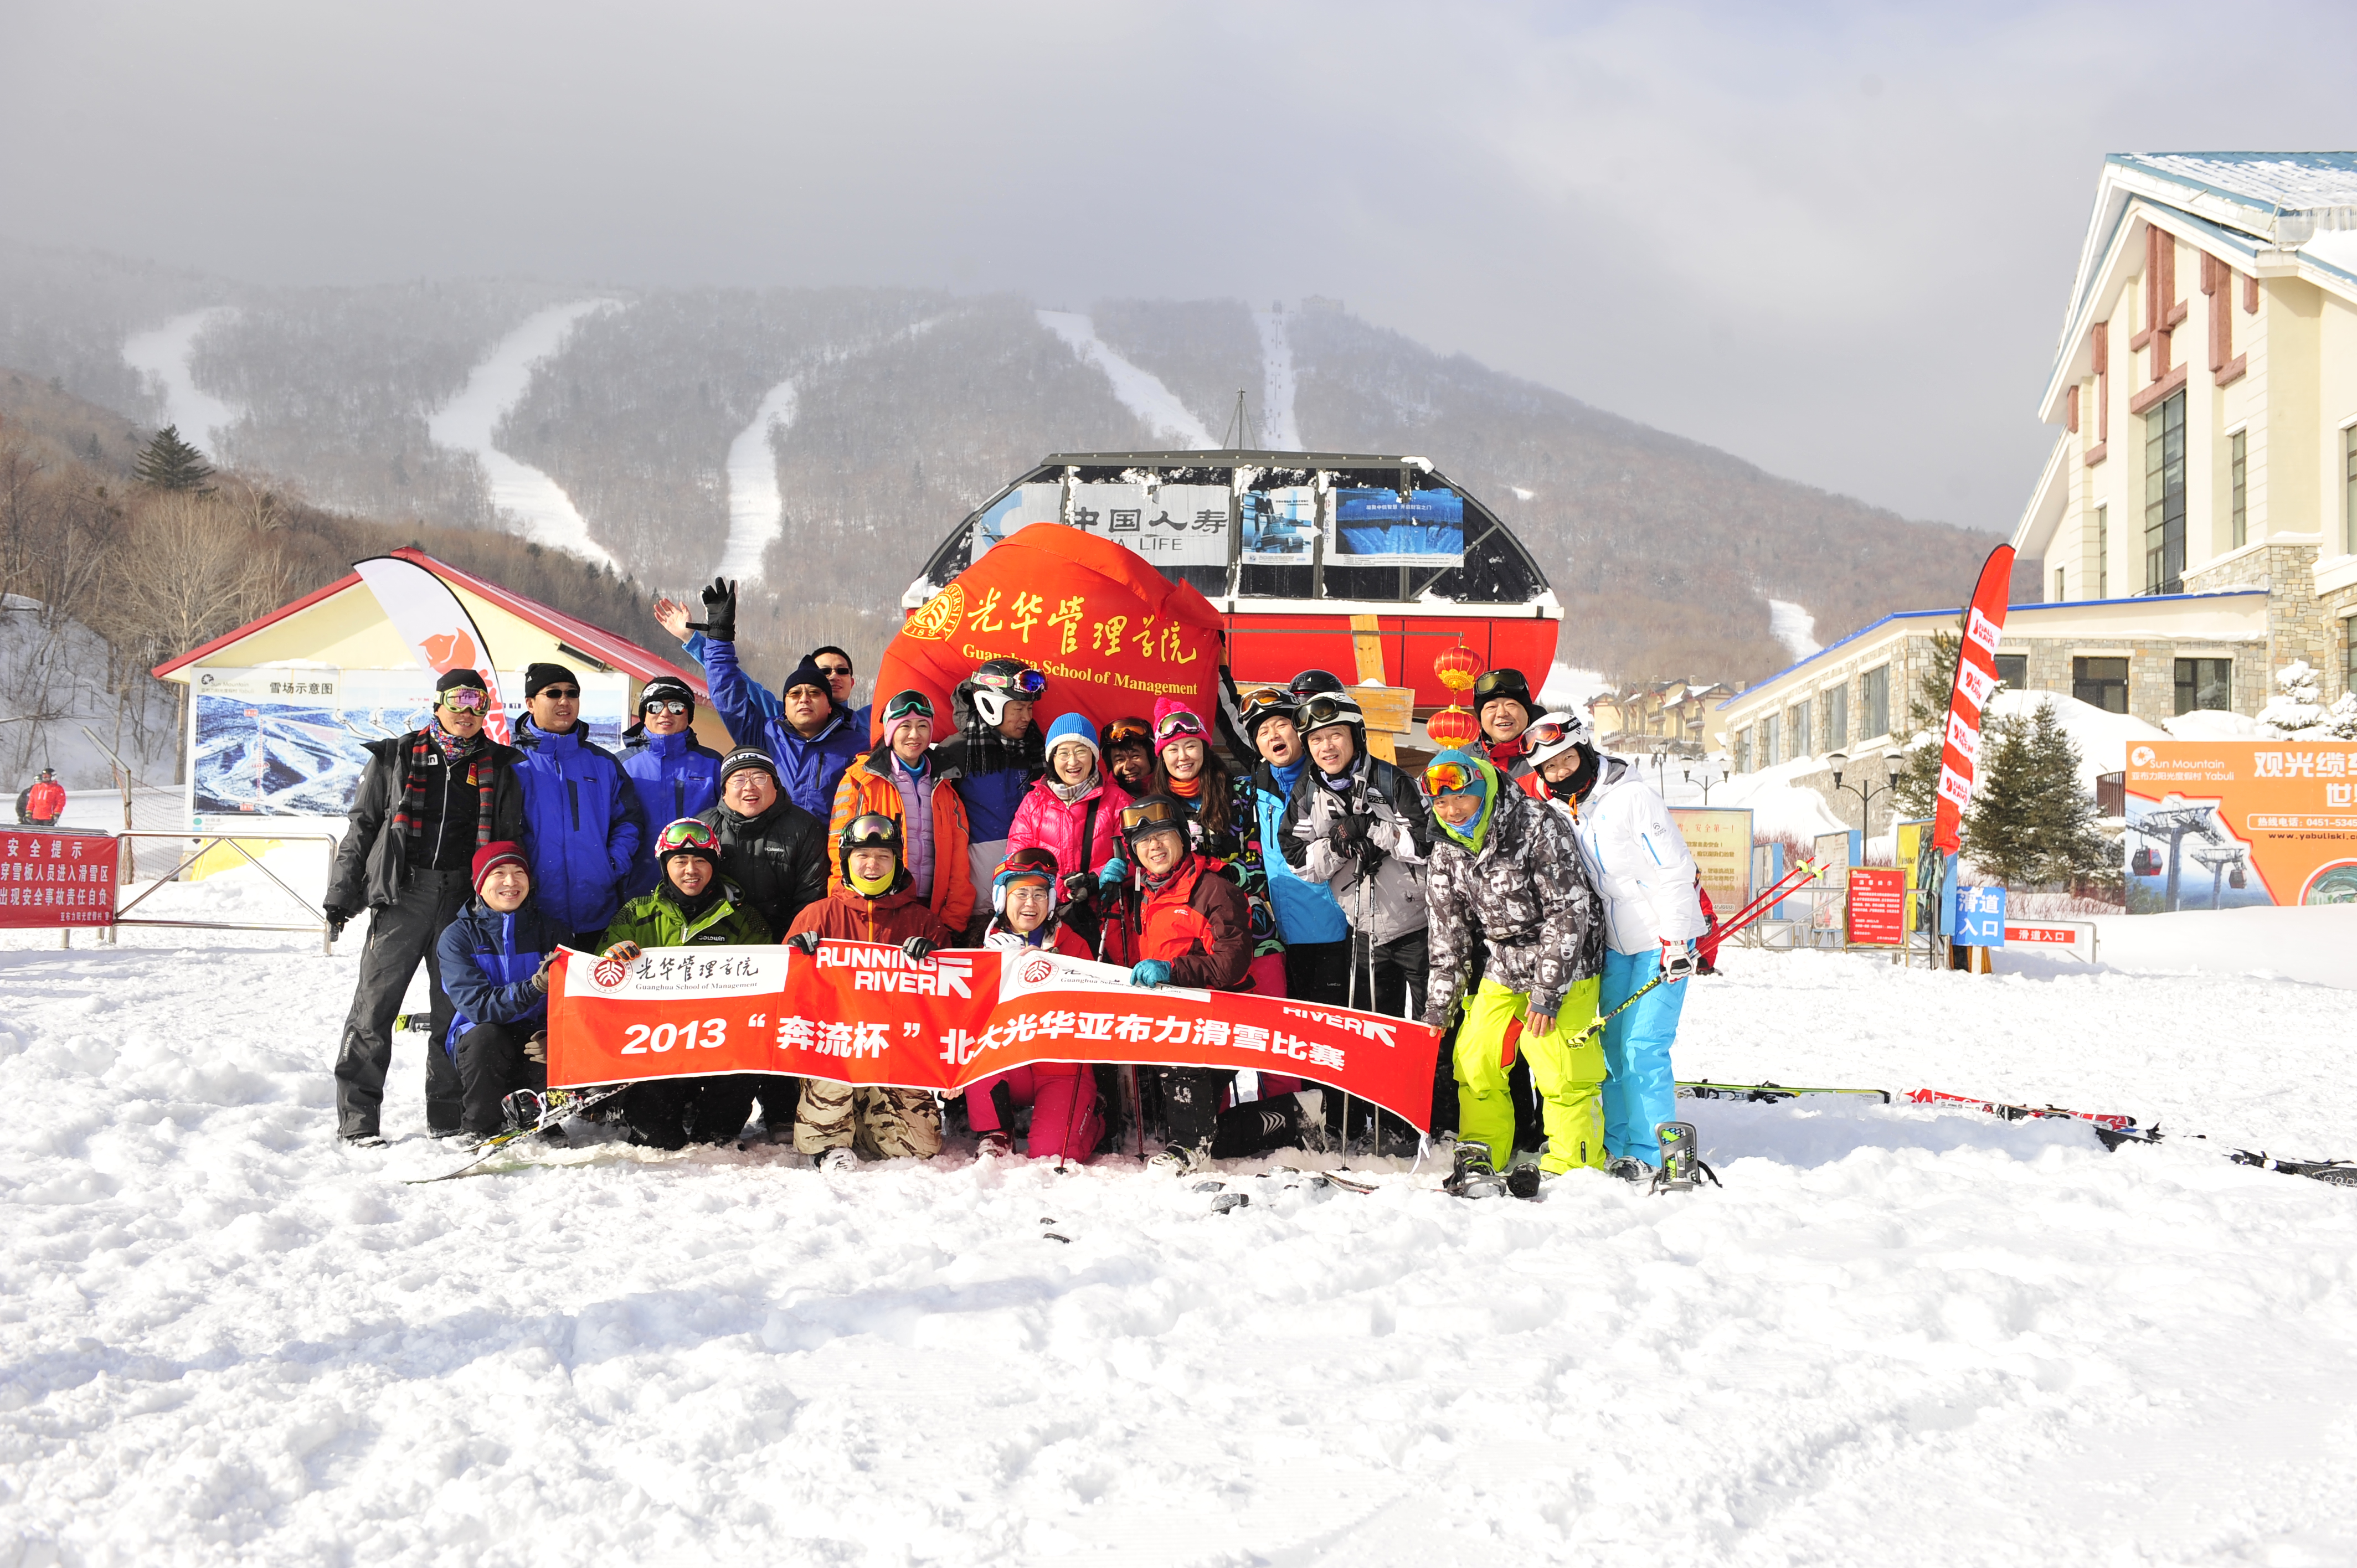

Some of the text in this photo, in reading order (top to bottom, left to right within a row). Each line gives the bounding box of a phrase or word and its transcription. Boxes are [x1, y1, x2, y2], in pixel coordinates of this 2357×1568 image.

[1073, 506, 1228, 534] 中国人寿
[1140, 538, 1183, 550] LIFE
[967, 586, 1197, 664] 光华管理学院
[269, 682, 333, 695] 雪场示意图
[1042, 660, 1092, 682] School
[1094, 670, 1111, 685] of
[1113, 672, 1198, 697] Management
[2149, 759, 2225, 769] Sun Mountain
[2131, 771, 2235, 781] 亚布力阳光度假村 Yabuli
[2325, 783, 2357, 807] 世
[2257, 817, 2303, 827] 热线电话：
[7, 838, 83, 859] 安全提示
[0, 862, 109, 883] 穿雪板人员进入滑雪区
[0, 887, 107, 906] 出现安全事故责任自负
[1958, 893, 1999, 914] 滑道
[1959, 918, 1999, 937] 入口
[2018, 929, 2065, 941] 滑道入口
[636, 955, 759, 983] 光华管理学院
[816, 946, 937, 972] RUNNING
[635, 983, 674, 992] Guanghua
[710, 982, 758, 991] Management
[854, 970, 937, 996] RIVER
[1283, 1006, 1362, 1035] RIVER
[621, 1010, 1346, 1071] 2013 “奔流杯” 北大光华亚布力滑雪比赛
